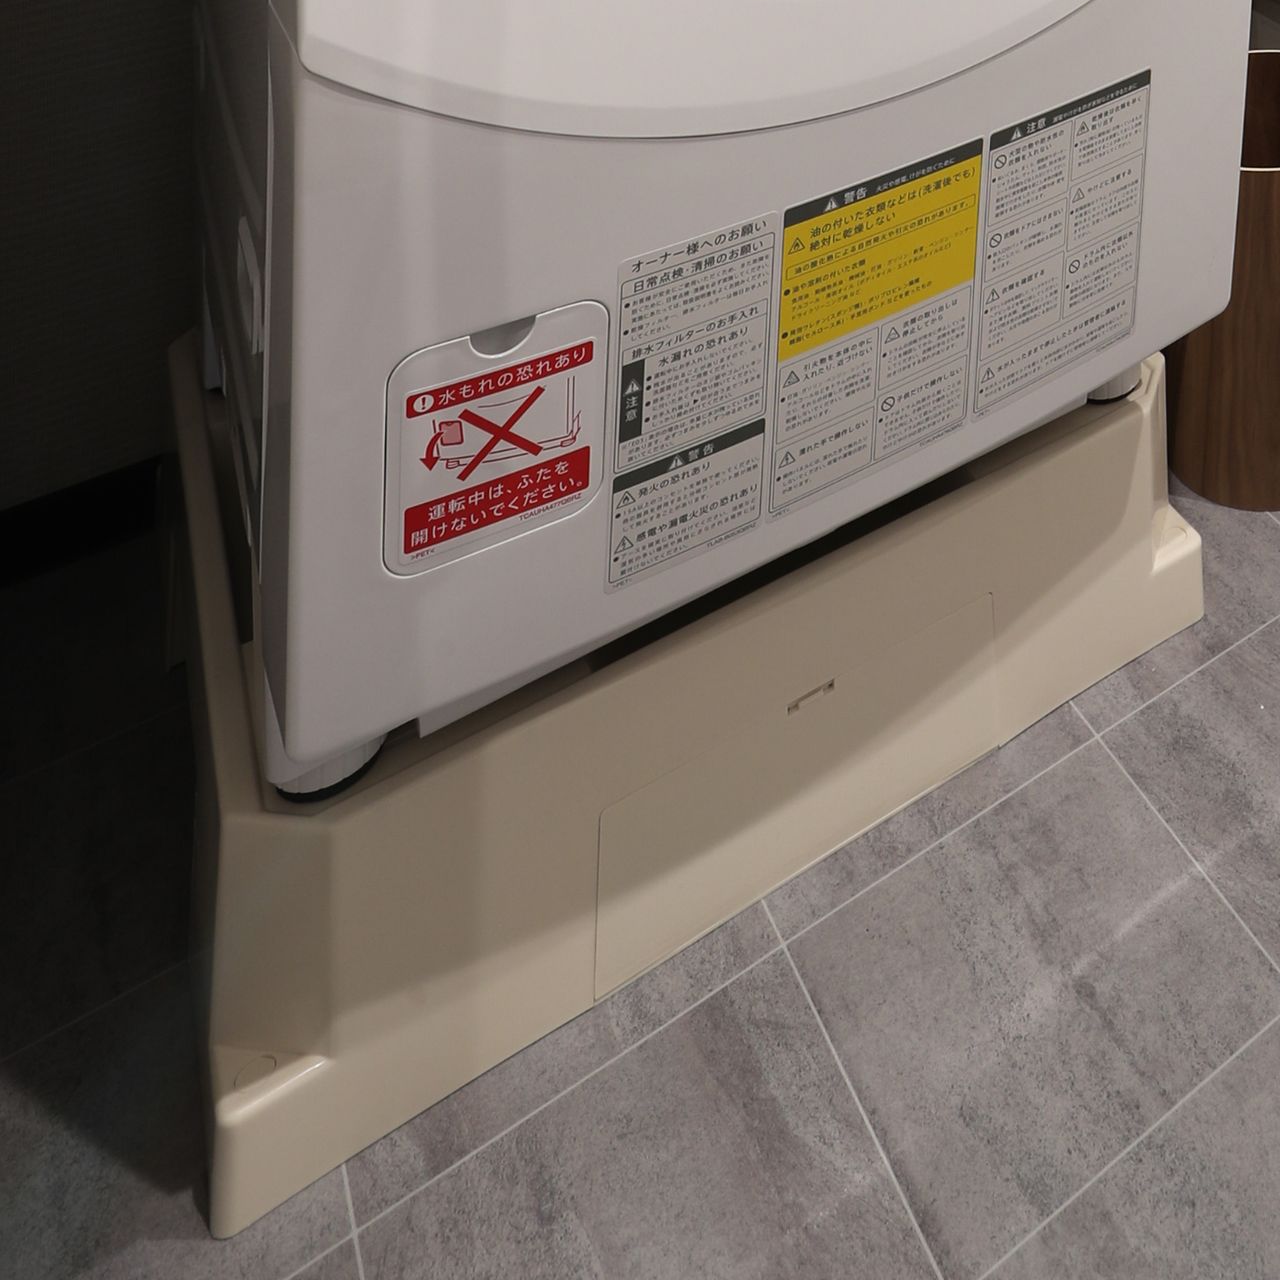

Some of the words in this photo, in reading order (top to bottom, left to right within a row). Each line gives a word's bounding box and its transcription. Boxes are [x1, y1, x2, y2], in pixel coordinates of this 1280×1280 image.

[1026, 118, 1047, 134] 注意
[843, 188, 868, 204] 警告
[631, 219, 767, 273] オーナー様へのお願い
[809, 214, 896, 253] 絶対に乾燥しない
[632, 241, 764, 293] 日常点検・清掃のお願い
[631, 306, 759, 360] 排水フィルターのお手入れ
[658, 327, 748, 367] 水漏れの恐れあり
[437, 348, 587, 407] 水もれの恐れあり
[688, 444, 715, 462] 警告
[427, 460, 569, 522] 運転中は、ふたを
[638, 462, 711, 498] 発火の恐れあり
[409, 478, 583, 547] 開けないでください。
[635, 484, 758, 542] 感電や漏電火災の恐れあり
